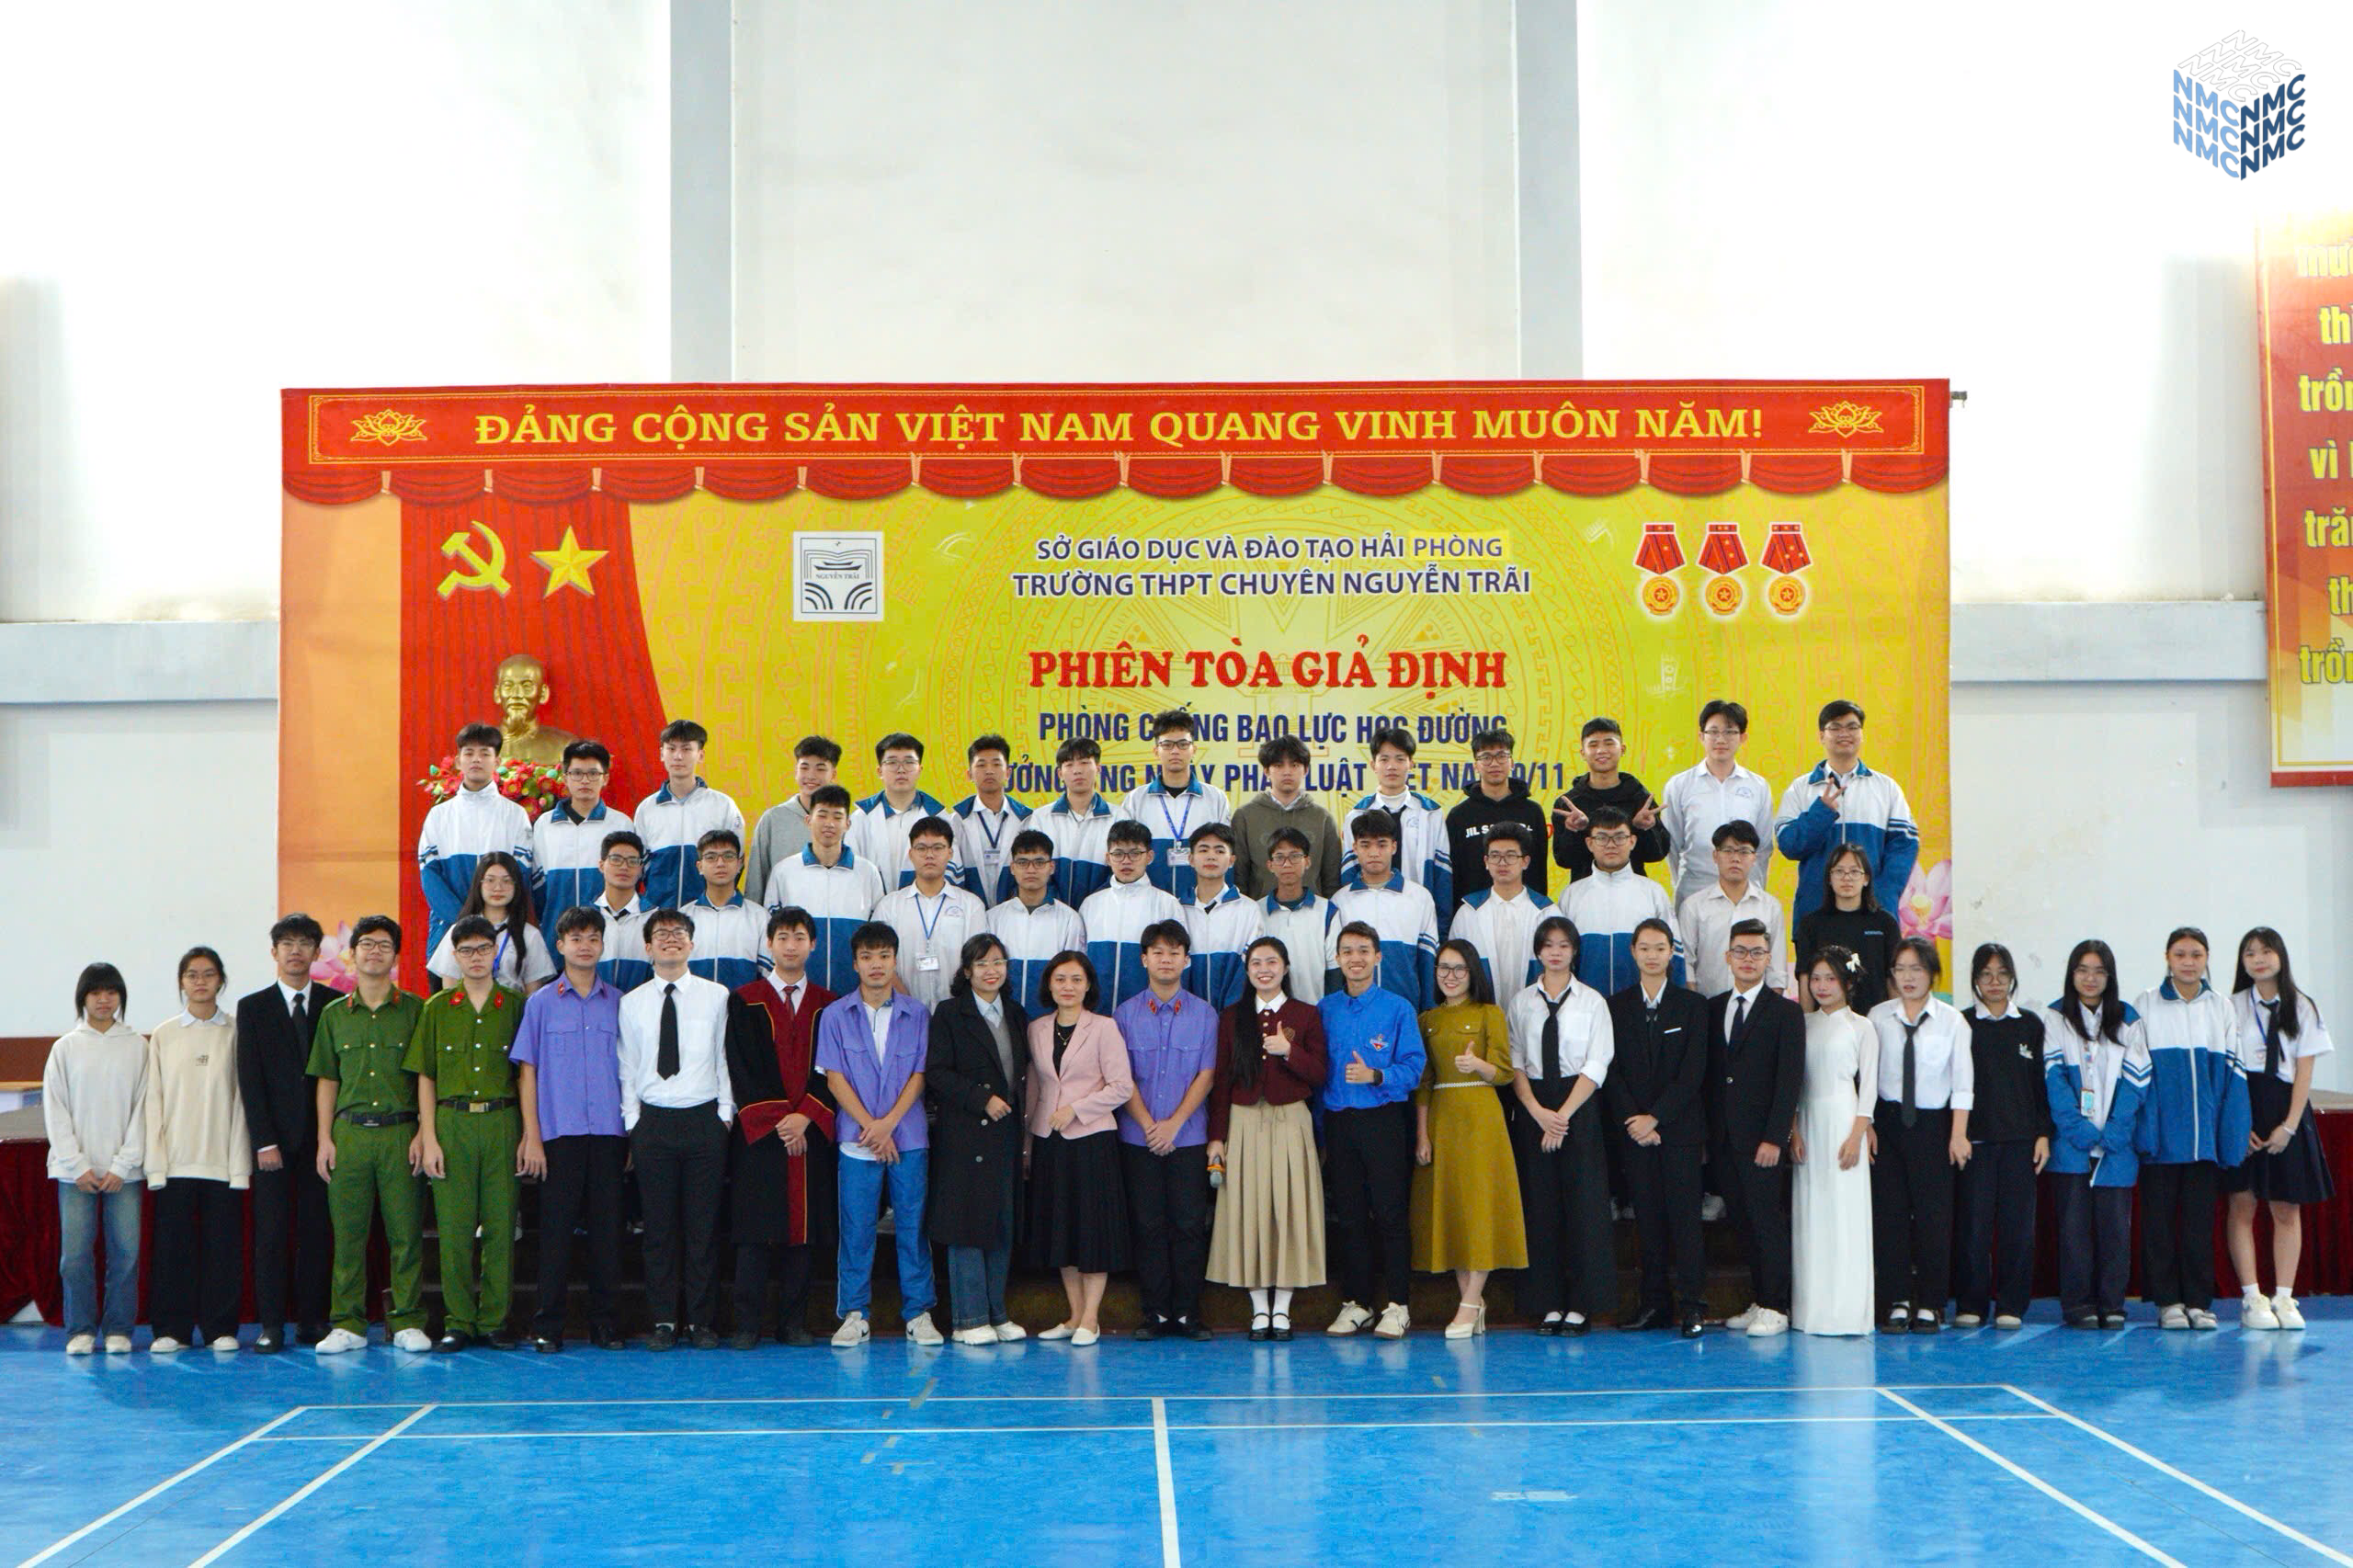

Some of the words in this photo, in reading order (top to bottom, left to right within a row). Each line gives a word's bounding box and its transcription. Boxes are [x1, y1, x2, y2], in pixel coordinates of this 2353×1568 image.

[2319, 303, 2353, 346] th
[474, 403, 618, 445] ĐẢNG
[632, 403, 769, 450] CỘNG
[784, 403, 881, 442] SẢN
[895, 403, 1005, 450] VIỆT
[1019, 412, 1134, 441] NAM
[1150, 411, 1321, 449] QUANG
[1335, 410, 1457, 440] VINH
[1472, 401, 1620, 438] MUÔN
[1634, 401, 1764, 438] NĂM!
[2308, 438, 2339, 480] vì
[1037, 534, 1072, 560] SỞ
[1078, 536, 1140, 560] GIÁO
[1148, 540, 1199, 565] DỤC
[1206, 535, 1238, 559] VÀ
[1245, 535, 1300, 559] ĐÀO
[1305, 539, 1354, 563] TẠO
[1361, 532, 1404, 558] HẢI
[1414, 534, 1503, 557] PHÒNG
[2303, 506, 2353, 549] tră
[1013, 570, 1133, 597] TRƯỜNG
[1140, 574, 1213, 596] THPT
[1220, 569, 1335, 596] CHUYÊN
[1344, 563, 1461, 594] NGUYỄN
[1467, 566, 1530, 593] TRÃI
[1029, 641, 1175, 687] PHIÊN
[1185, 637, 1283, 687] TÒA
[1291, 634, 1378, 687] GIẢ
[1387, 651, 1507, 699] ĐỊNH
[1040, 705, 1130, 741] PHÒNG
[1299, 712, 1347, 750] LỰC
[1305, 757, 1367, 798] LUẬT
